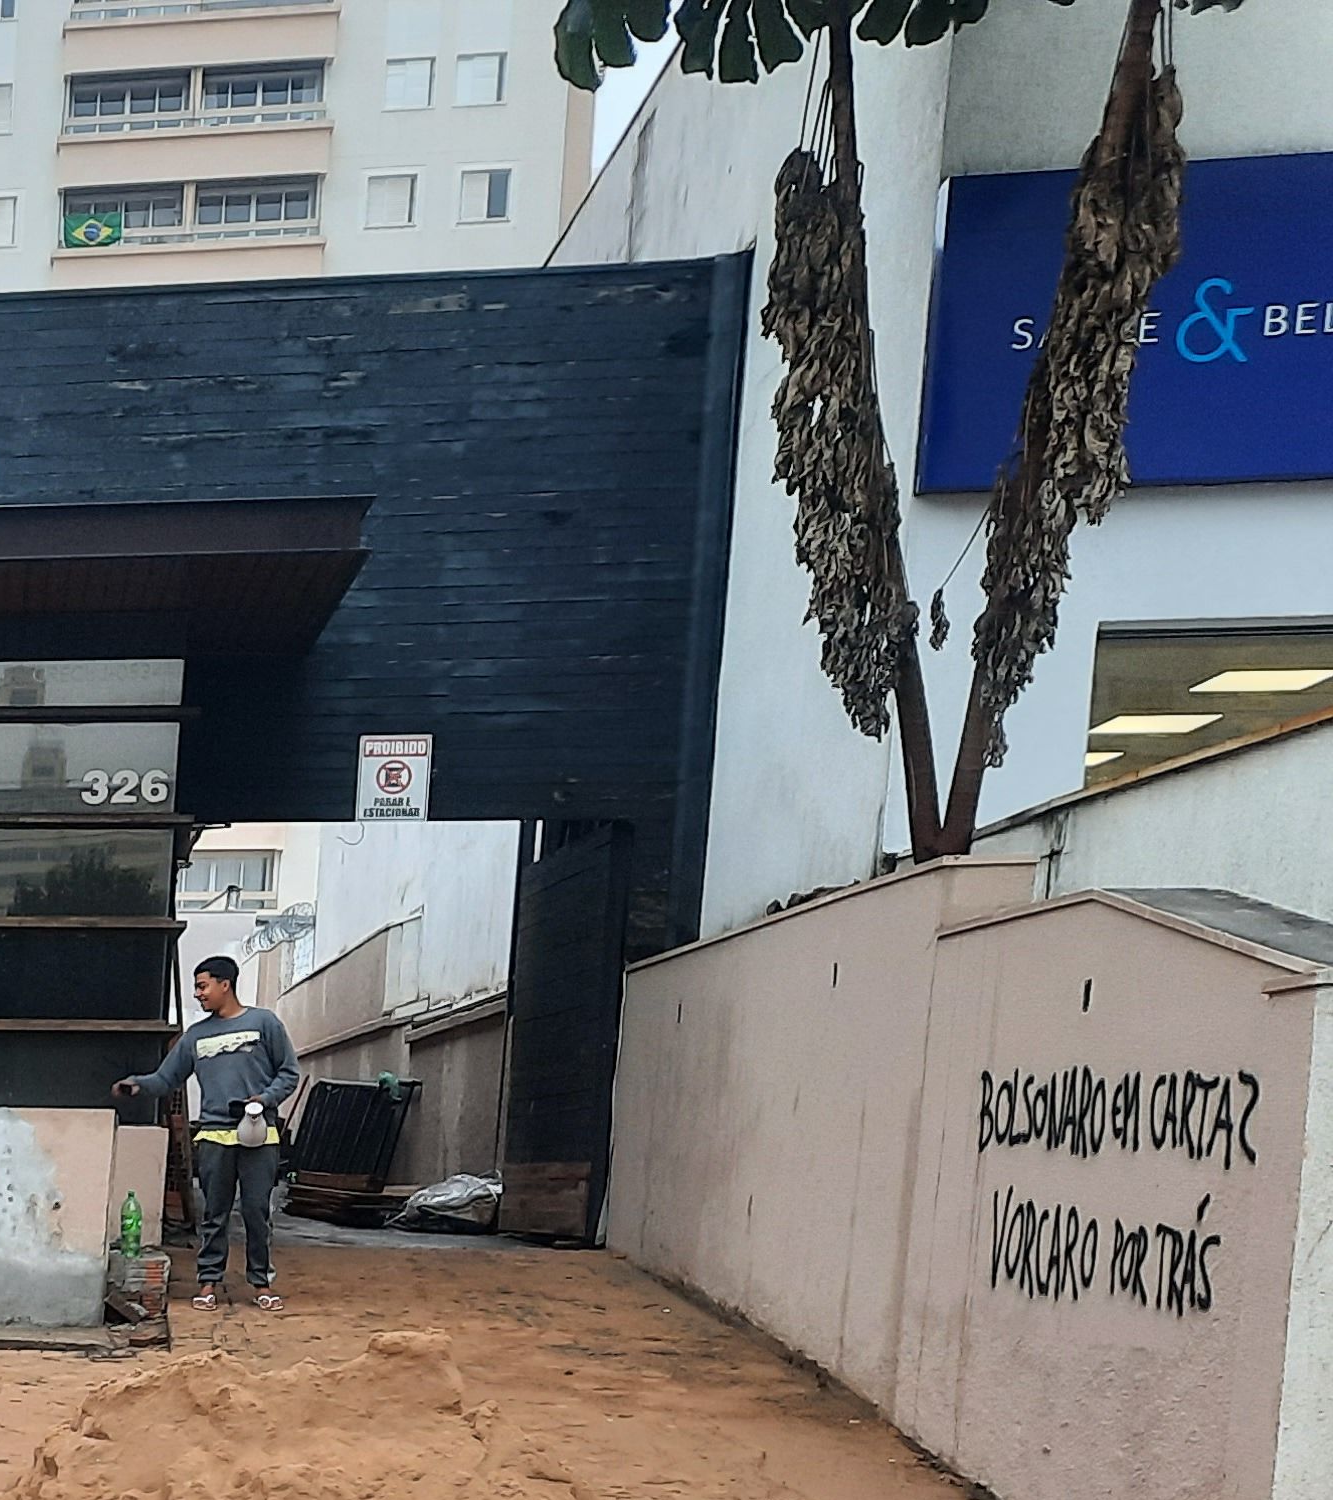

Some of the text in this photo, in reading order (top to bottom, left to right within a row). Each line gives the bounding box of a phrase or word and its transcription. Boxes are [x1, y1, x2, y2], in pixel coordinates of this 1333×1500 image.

[1176, 278, 1254, 362] &
[364, 740, 428, 756] PROIBIDO
[81, 769, 169, 805] 326
[373, 797, 404, 807] PARAR
[363, 807, 421, 818] ESTACIONAR
[978, 1064, 1106, 1159] BOLSONARO
[991, 1184, 1222, 1318] VORCARO POR TRÁS
